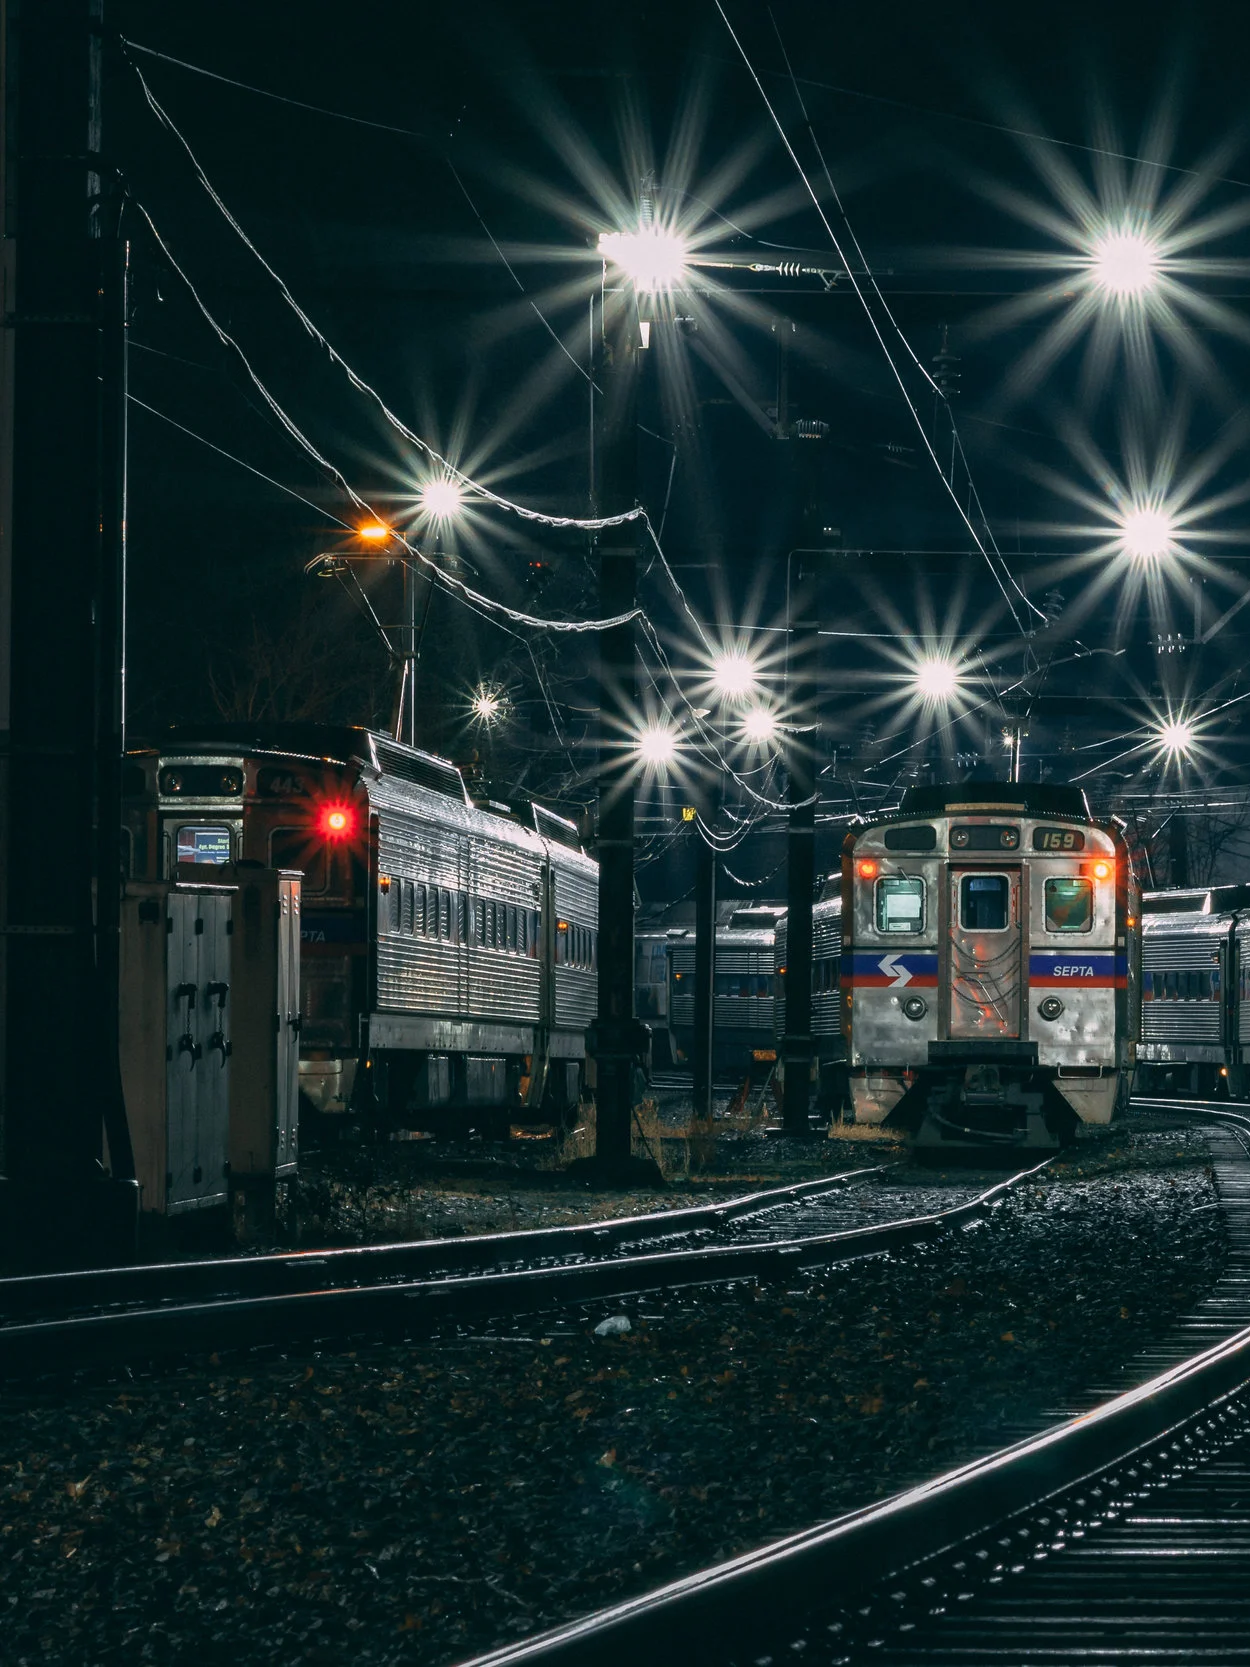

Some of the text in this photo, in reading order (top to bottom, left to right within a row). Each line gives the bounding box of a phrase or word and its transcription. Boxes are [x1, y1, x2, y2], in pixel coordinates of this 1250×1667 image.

[1043, 832, 1075, 849] 159
[300, 930, 325, 942] PTA
[1053, 965, 1094, 977] SEPTA
